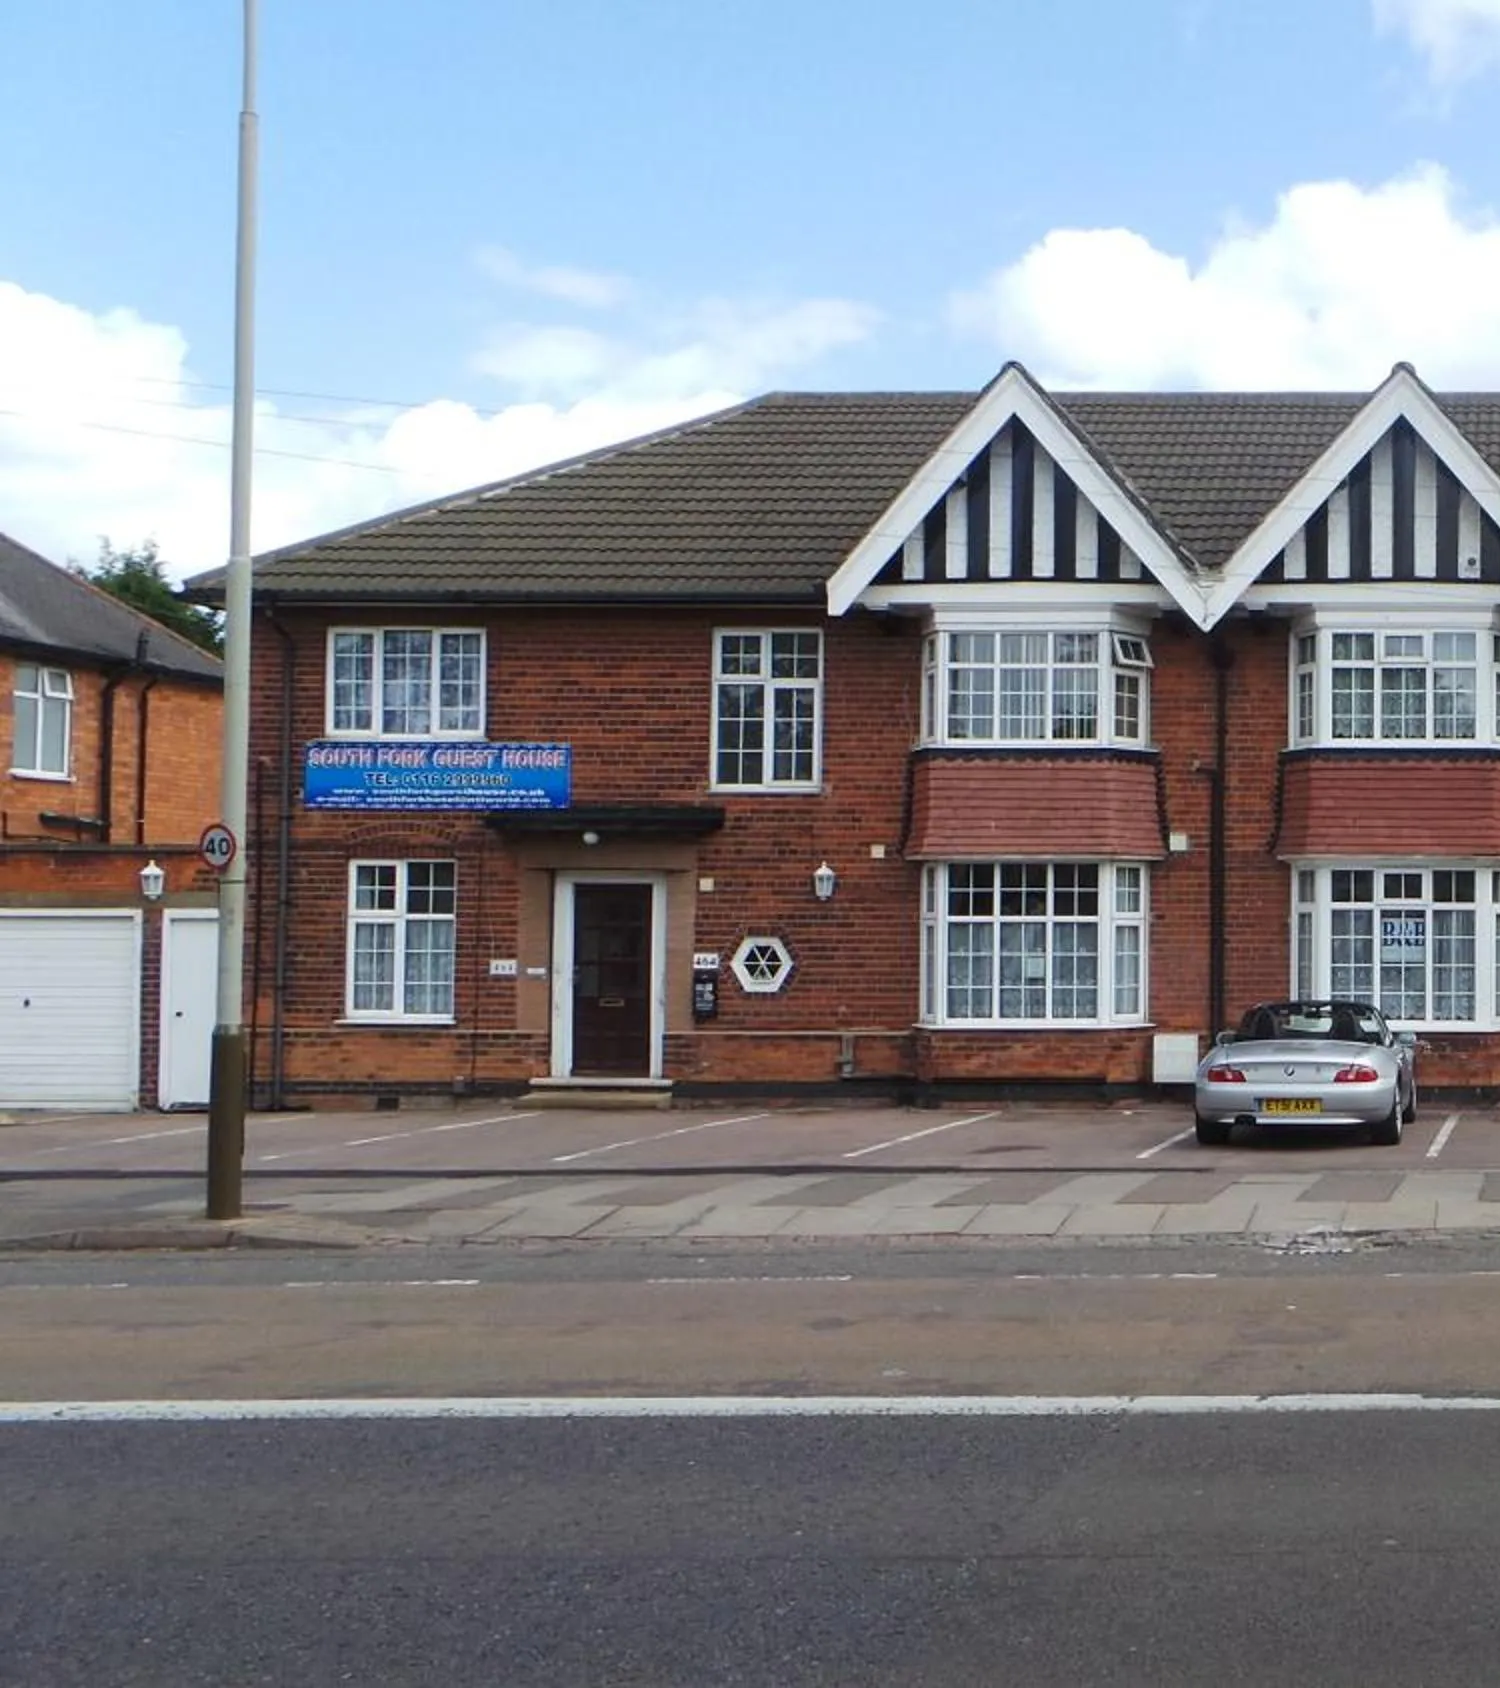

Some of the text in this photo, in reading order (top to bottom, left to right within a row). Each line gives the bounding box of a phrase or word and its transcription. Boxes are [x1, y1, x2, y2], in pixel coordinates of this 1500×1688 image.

[308, 747, 568, 769] SOUTH FORK GUEST HOUSE
[206, 837, 231, 856] 40
